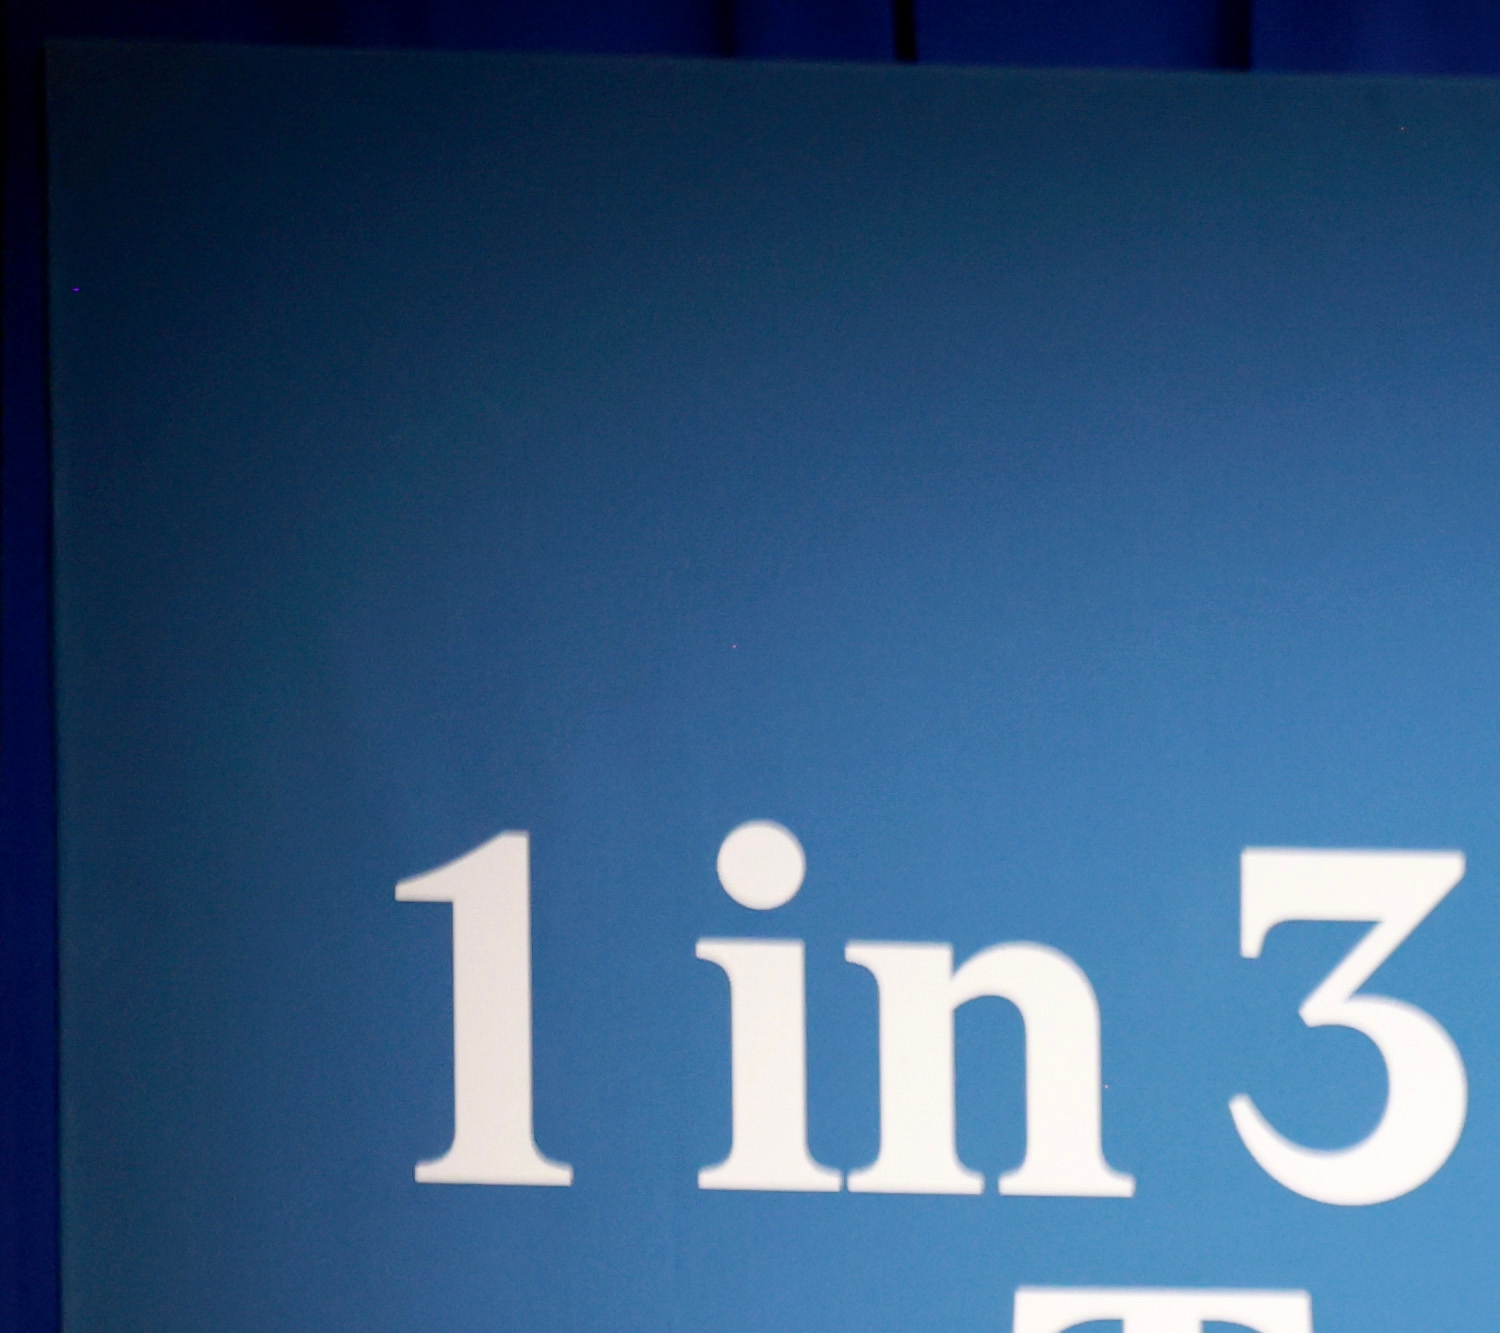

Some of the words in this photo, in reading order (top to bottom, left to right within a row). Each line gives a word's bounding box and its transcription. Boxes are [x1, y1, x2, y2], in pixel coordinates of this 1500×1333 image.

[394, 831, 574, 1187] 1
[693, 819, 1138, 1200] in
[1227, 846, 1470, 1208] 3
